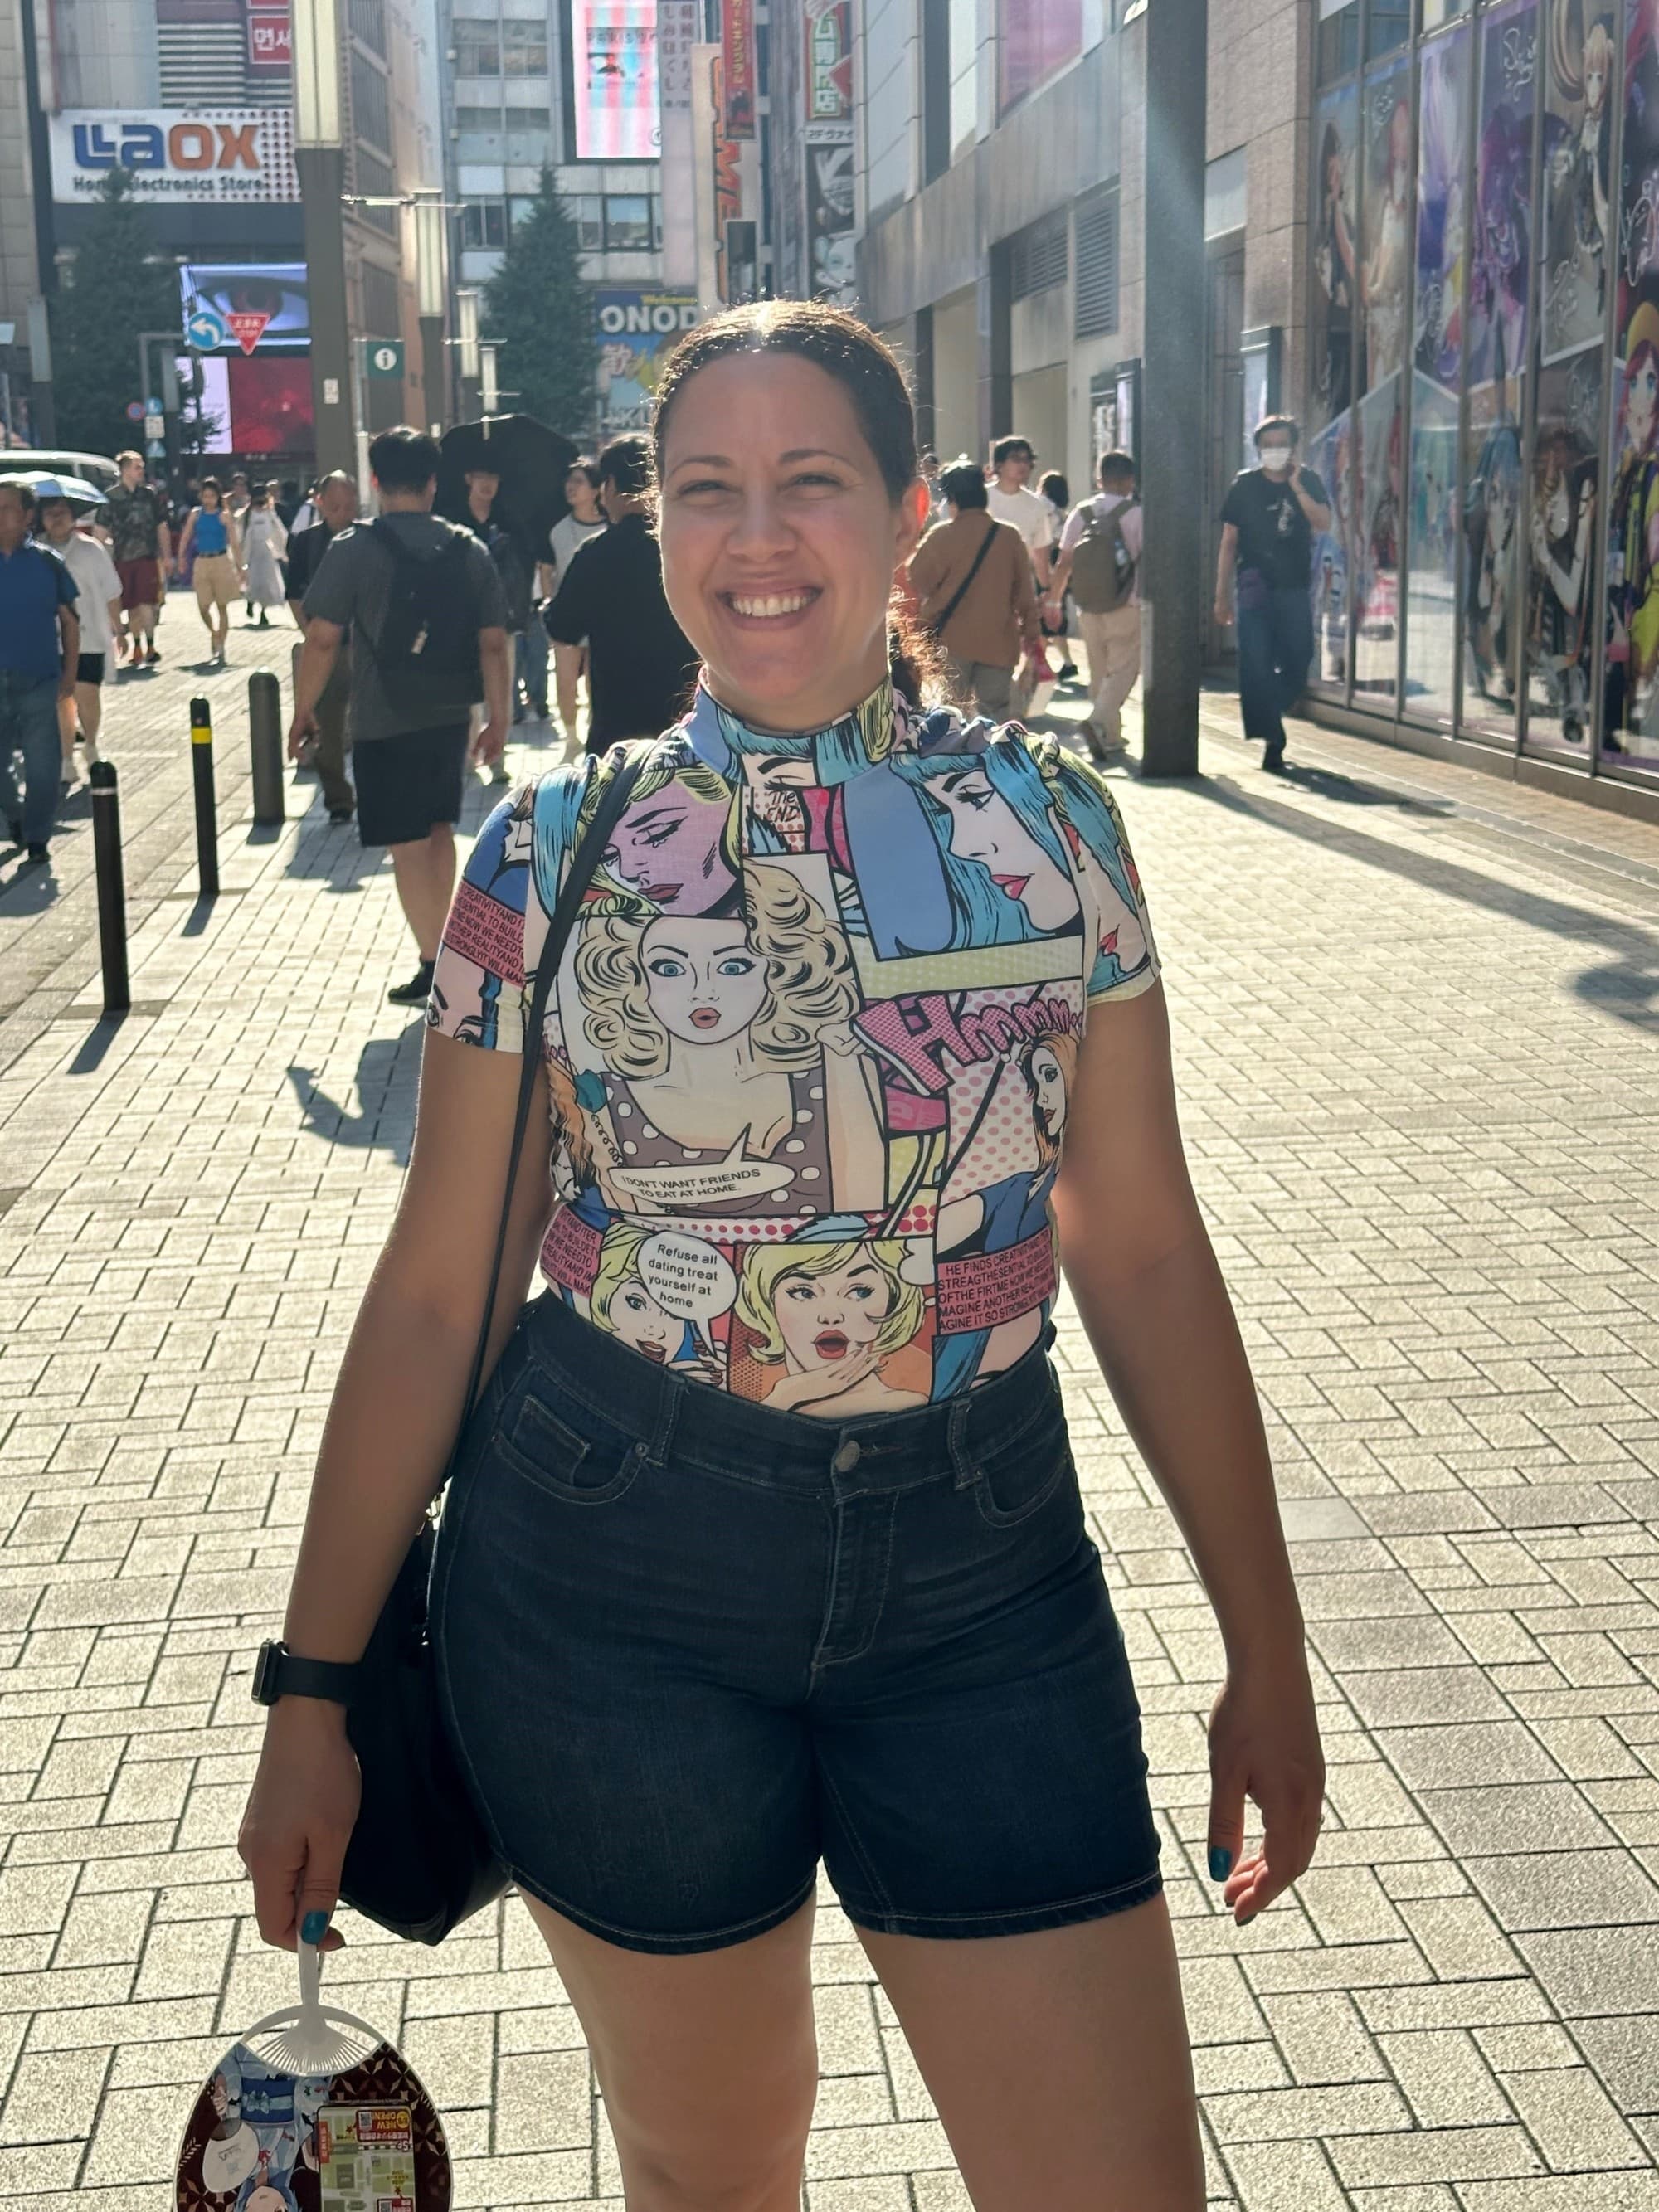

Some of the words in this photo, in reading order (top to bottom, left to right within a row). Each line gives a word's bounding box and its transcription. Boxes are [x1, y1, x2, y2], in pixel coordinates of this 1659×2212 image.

[133, 176, 214, 192] lectronics
[219, 176, 262, 192] Store
[768, 790, 795, 805] The
[764, 805, 801, 823] END
[489, 915, 498, 930] TO
[481, 925, 494, 940] WE
[659, 1179, 697, 1189] WANT
[699, 1168, 761, 1186] FRIENDS
[638, 1189, 654, 1198] TO
[655, 1190, 677, 1198] EAT
[679, 1189, 695, 1198] AT
[657, 1243, 698, 1262] Refuse
[702, 1254, 718, 1265] all
[649, 1258, 684, 1277] dating
[688, 1267, 718, 1281] treat
[946, 1263, 961, 1276] HE
[963, 1257, 993, 1274] FINDS
[648, 1274, 696, 1292] yourself
[698, 1286, 711, 1296] at
[659, 1291, 693, 1308] home
[983, 1288, 1021, 1310] ANOTHER
[975, 1313, 983, 1325] IT
[985, 1310, 999, 1323] SO
